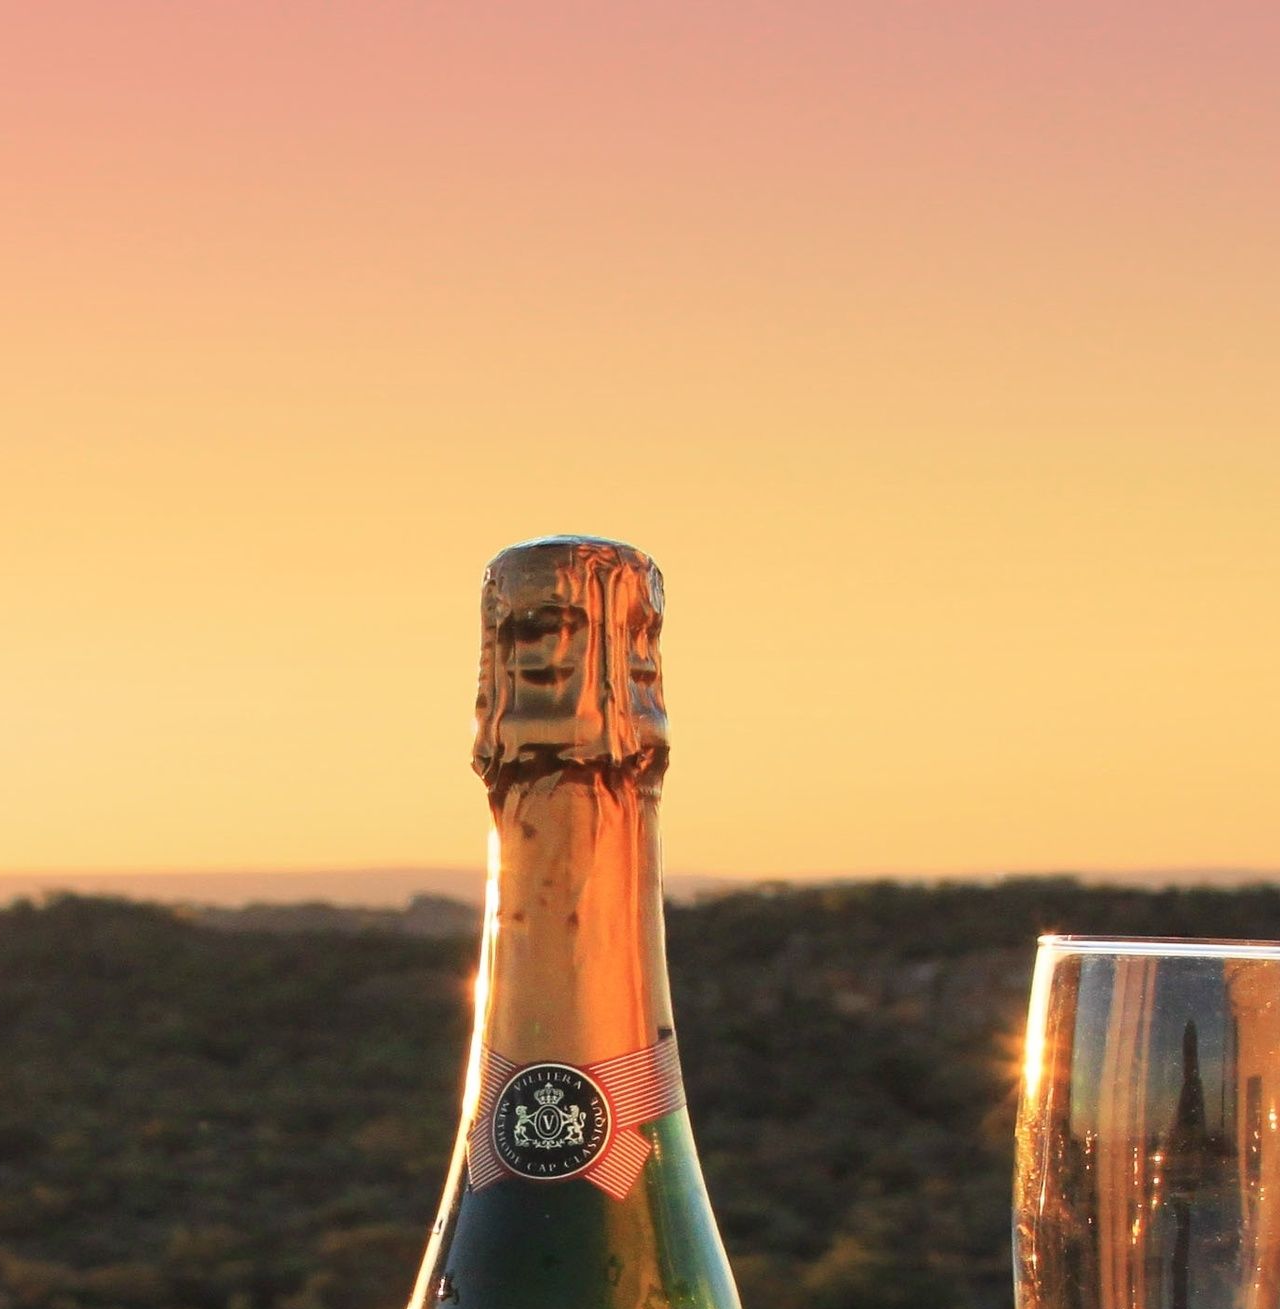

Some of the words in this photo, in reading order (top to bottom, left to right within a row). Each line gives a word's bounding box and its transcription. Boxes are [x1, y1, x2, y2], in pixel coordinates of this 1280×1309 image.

[514, 1072, 582, 1091] VILLIERA
[542, 1115, 555, 1130] V
[527, 1163, 557, 1172] CAP
